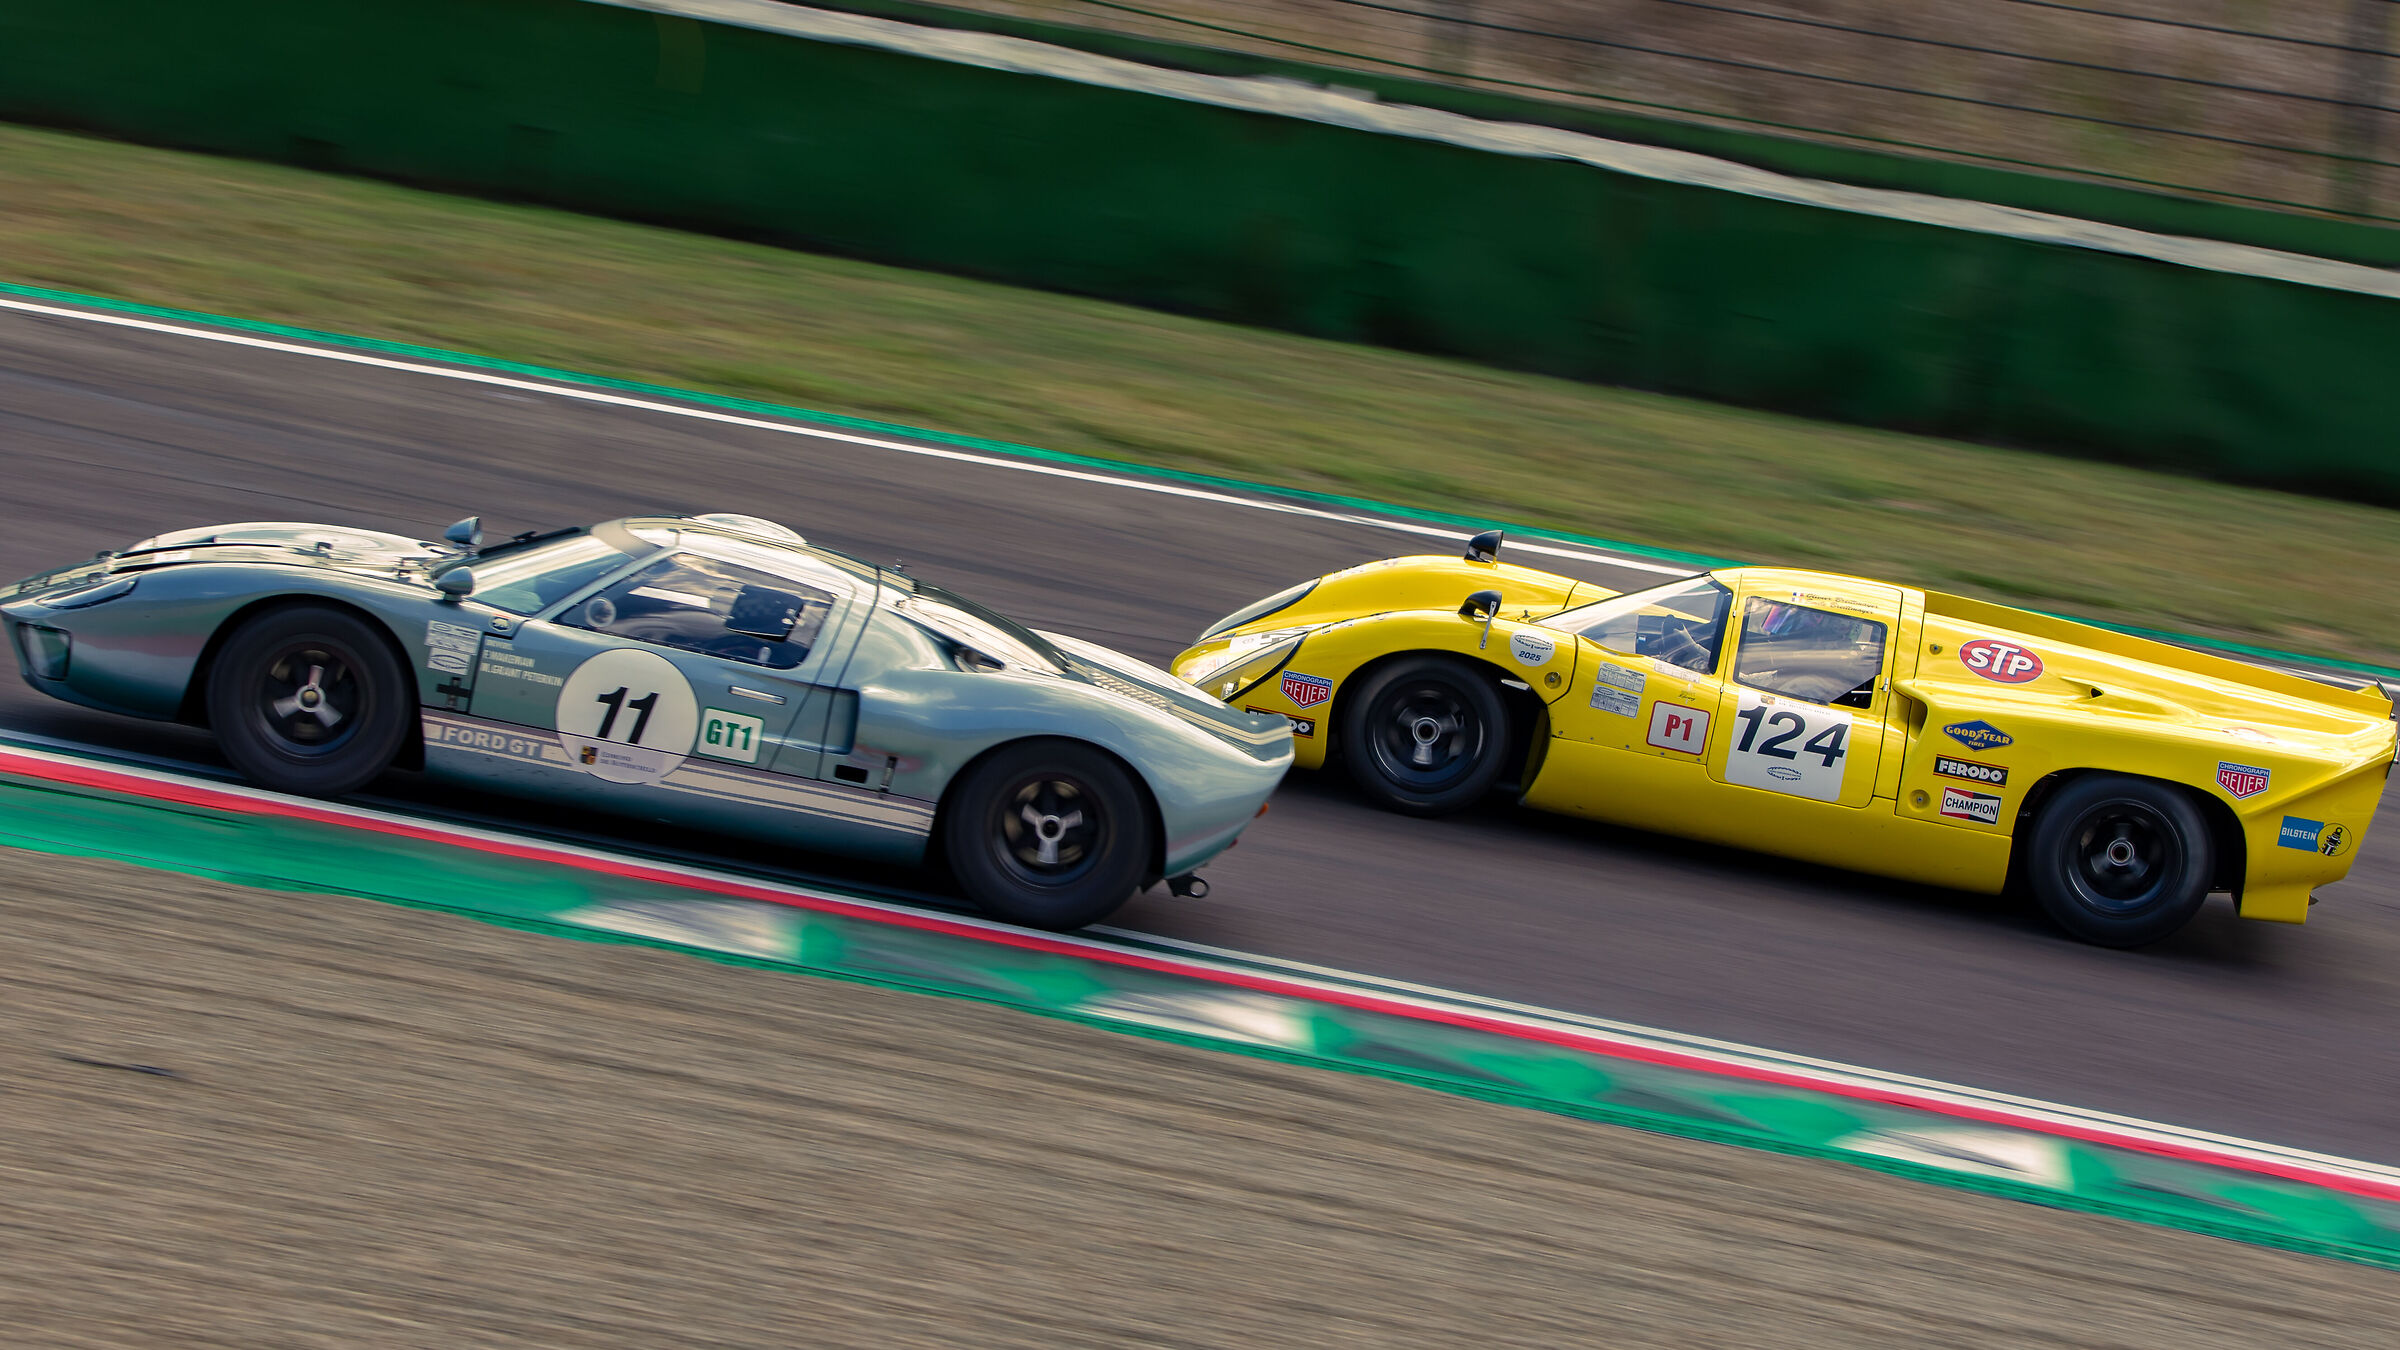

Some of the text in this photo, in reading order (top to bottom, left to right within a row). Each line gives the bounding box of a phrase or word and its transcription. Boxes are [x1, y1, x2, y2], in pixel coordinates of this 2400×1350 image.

[1518, 650, 1542, 662] 2025
[1966, 643, 2035, 677] STP
[1284, 672, 1332, 686] CHRONOGRAPH
[1285, 682, 1327, 704] HEUER
[595, 686, 660, 745] 11
[706, 719, 752, 751] GT1
[1664, 714, 1693, 741] P1
[1737, 705, 1848, 768] 124
[443, 727, 541, 757] FORD GT
[1967, 740, 1985, 748] TIRES
[1938, 759, 2004, 782] FERODO
[2220, 763, 2269, 776] CHRONOGRAPH
[2220, 772, 2264, 795] HEUER
[1945, 797, 1997, 816] CHAMPION
[2281, 827, 2317, 841] BILSTEIN
